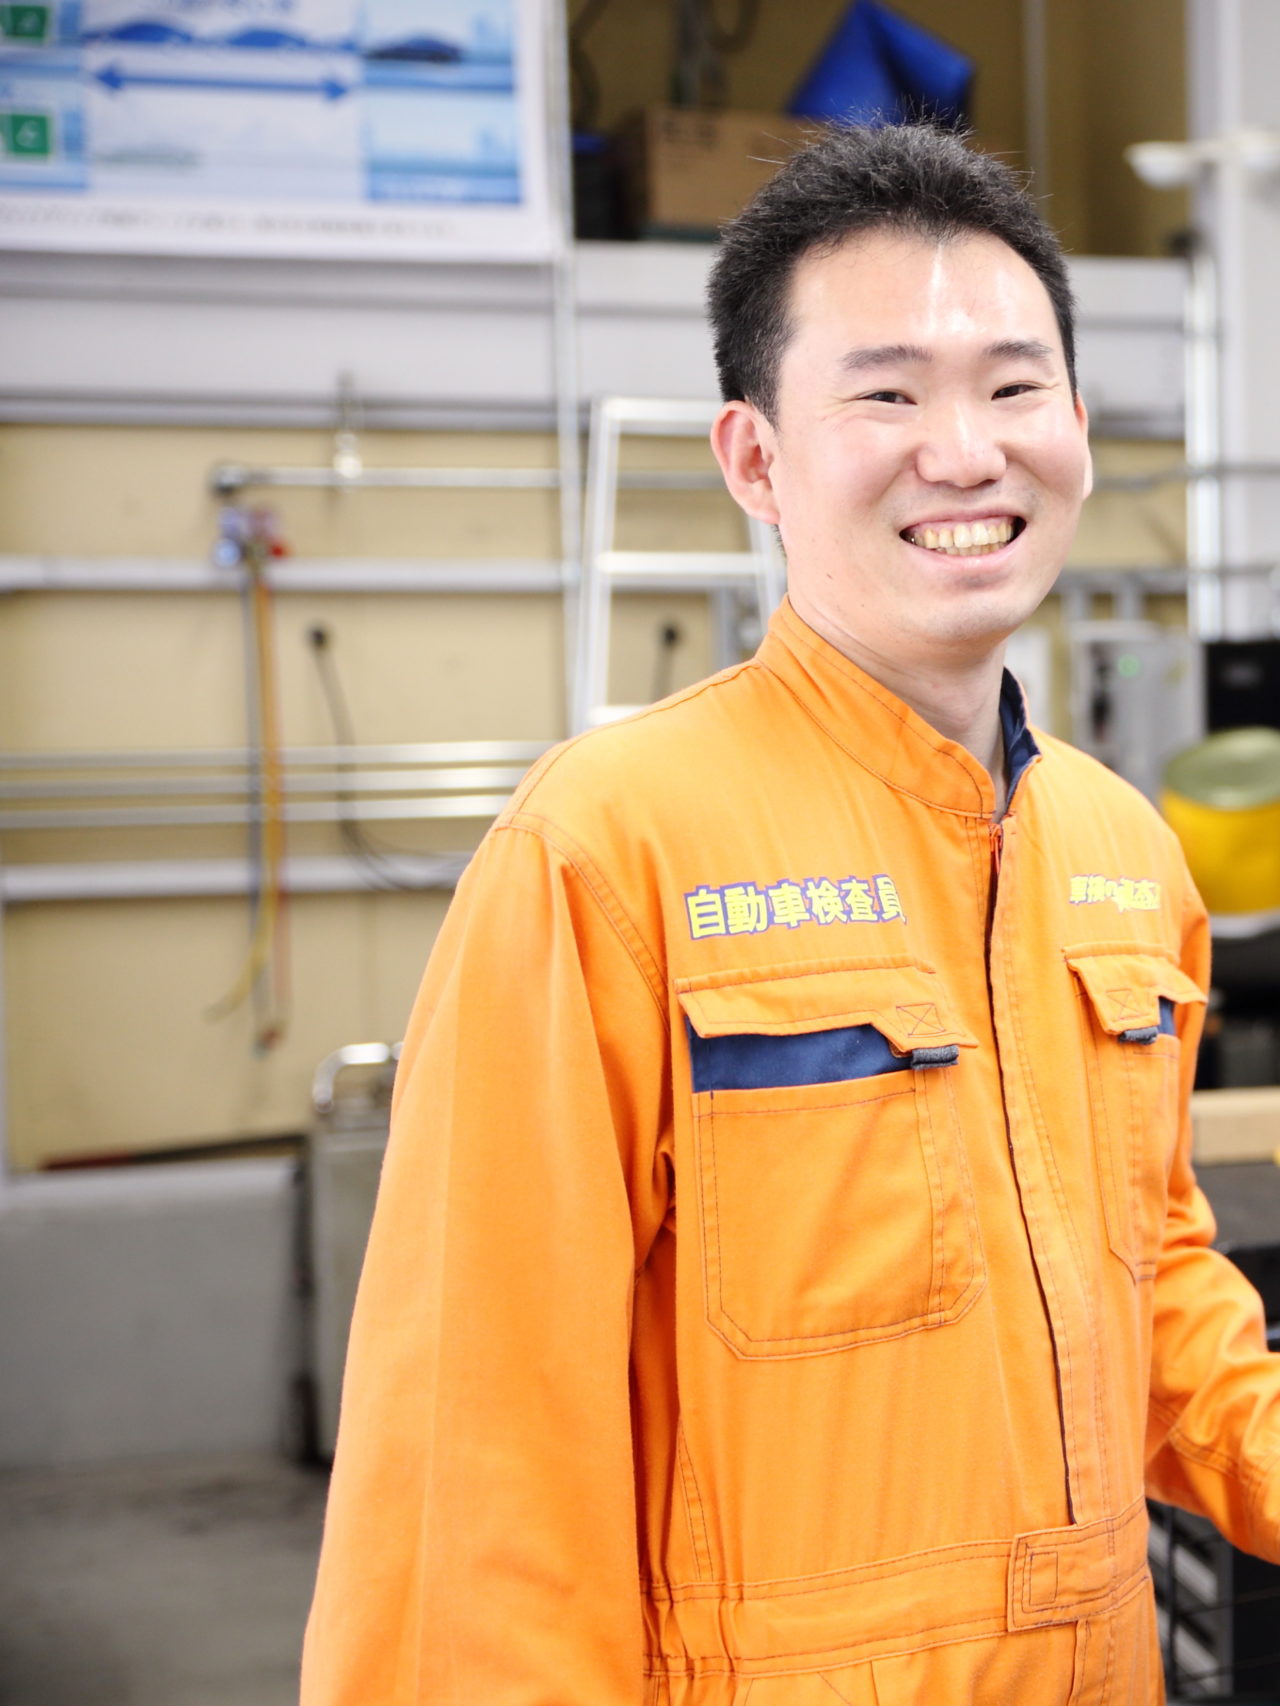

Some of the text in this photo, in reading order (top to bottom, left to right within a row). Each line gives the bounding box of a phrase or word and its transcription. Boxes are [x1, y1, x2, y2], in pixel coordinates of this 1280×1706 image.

[685, 874, 907, 940] 自動車検査員
